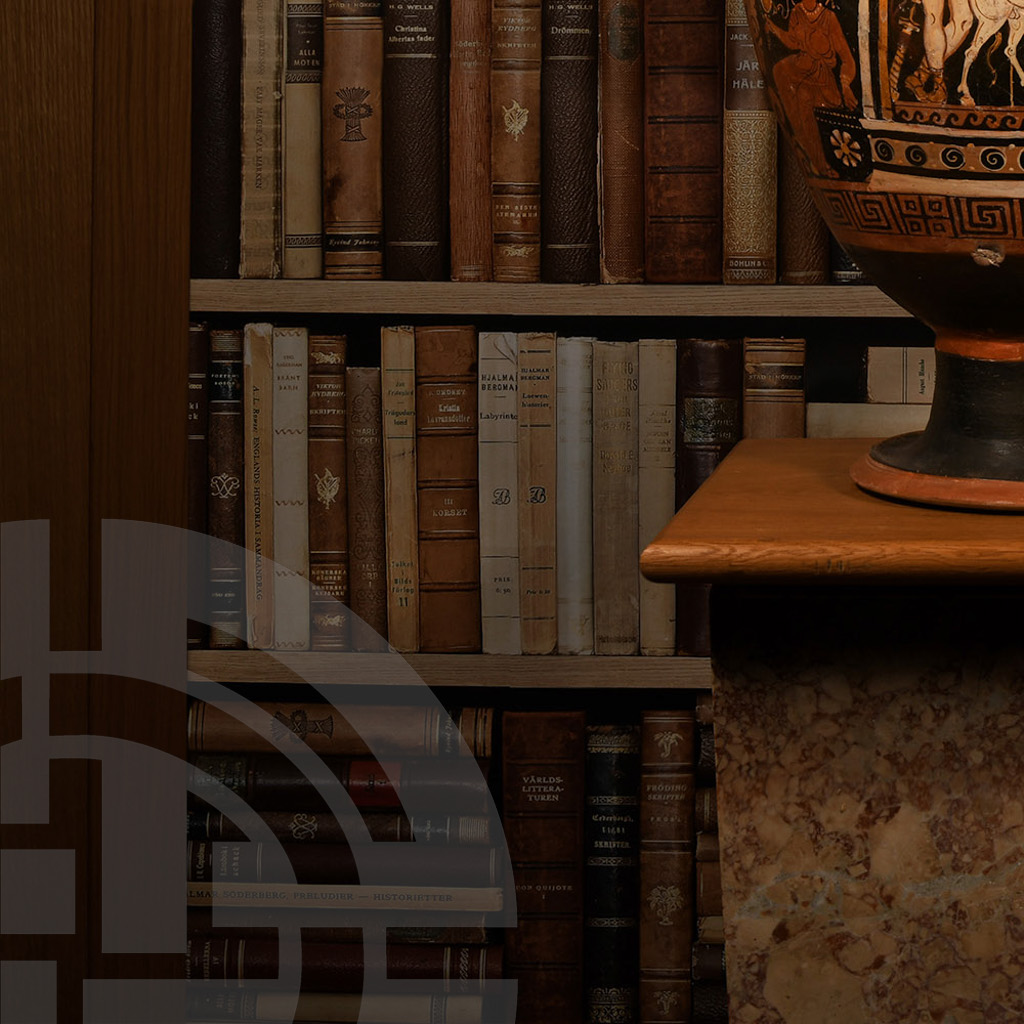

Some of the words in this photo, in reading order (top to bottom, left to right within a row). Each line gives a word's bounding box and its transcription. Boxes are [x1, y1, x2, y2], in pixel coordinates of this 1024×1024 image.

[253, 487, 261, 529] HISTORIA
[254, 537, 263, 600] SAMMANDRAG
[527, 794, 560, 802] TUREN
